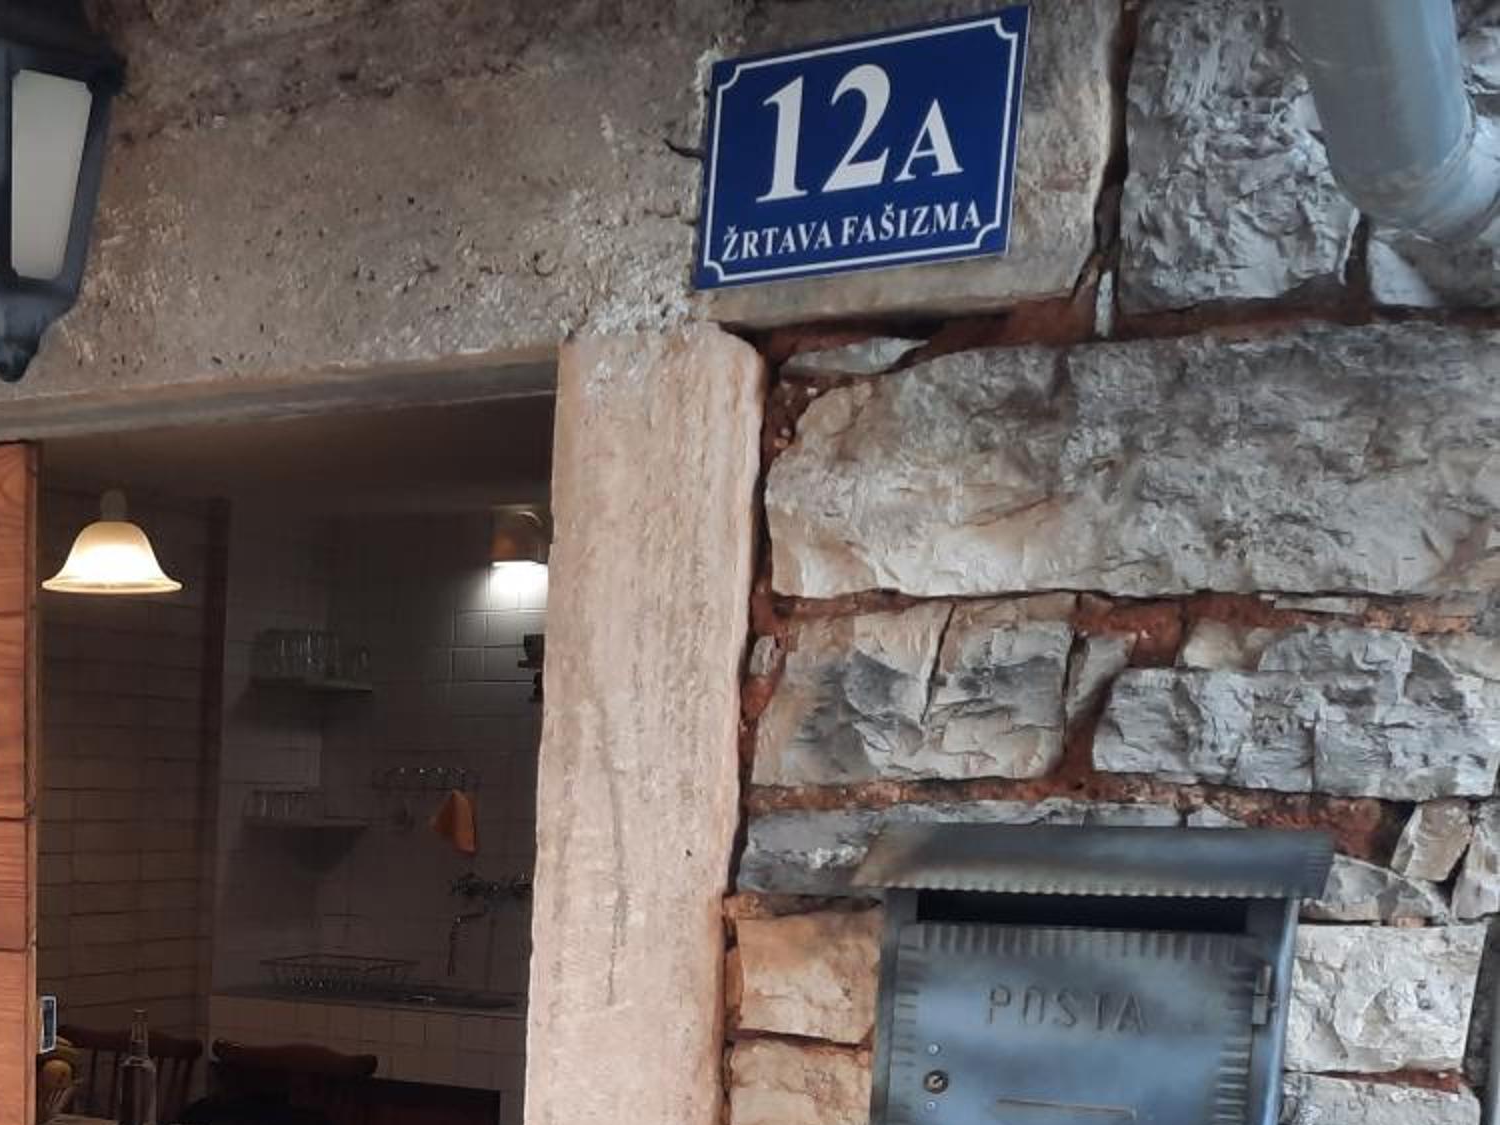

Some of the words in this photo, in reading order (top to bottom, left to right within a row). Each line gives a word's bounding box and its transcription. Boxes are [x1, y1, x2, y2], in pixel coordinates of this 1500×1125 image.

[755, 63, 964, 203] 12A
[720, 220, 833, 263] ŽRTAVA
[840, 199, 981, 247] FAŠIZMA
